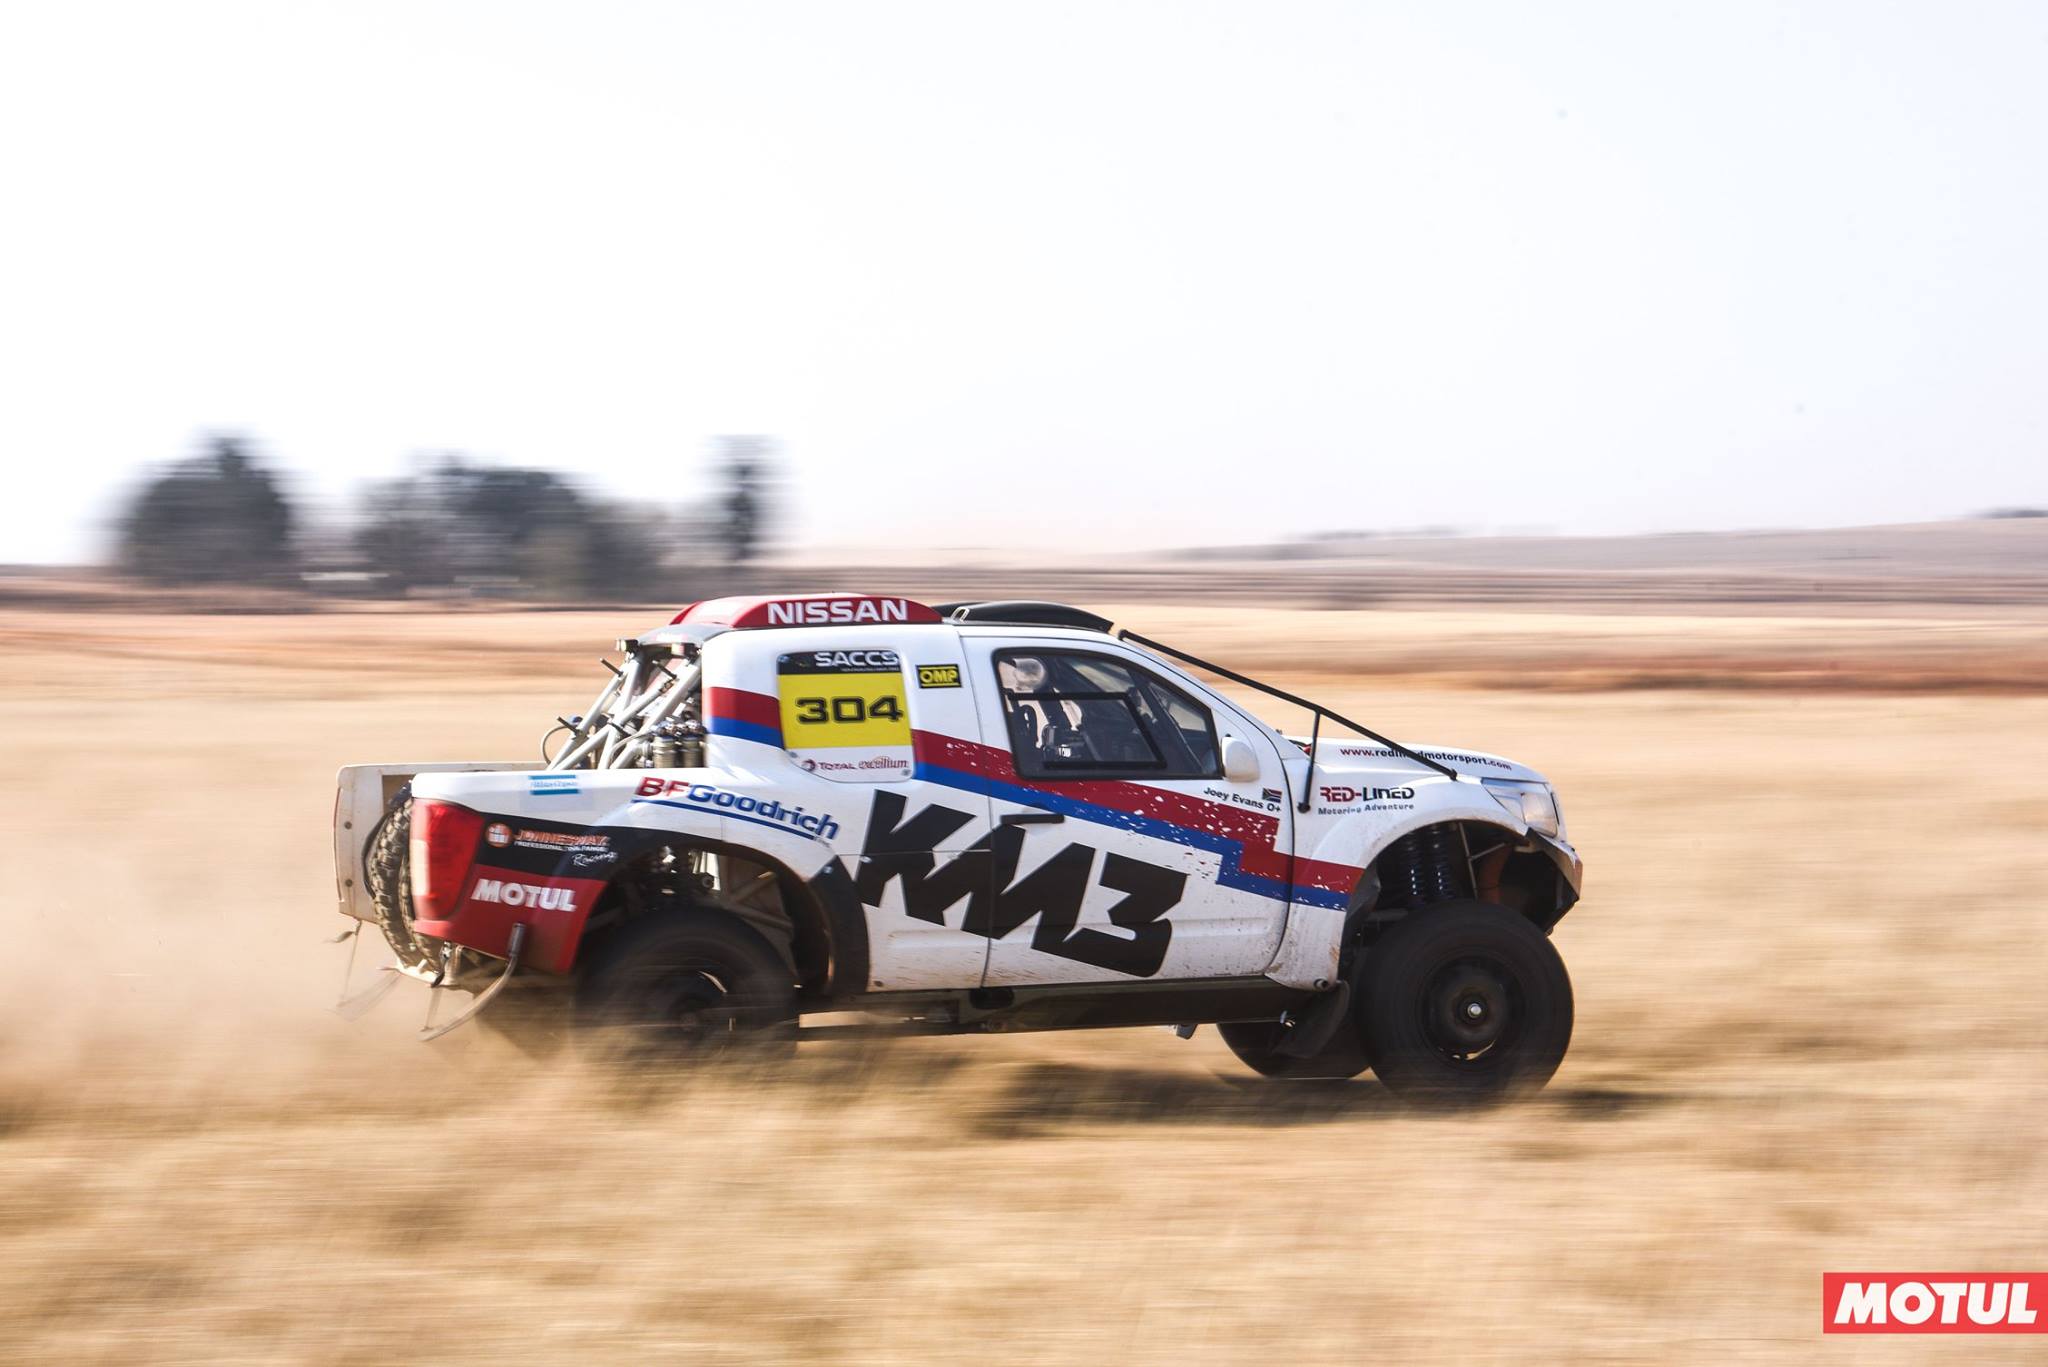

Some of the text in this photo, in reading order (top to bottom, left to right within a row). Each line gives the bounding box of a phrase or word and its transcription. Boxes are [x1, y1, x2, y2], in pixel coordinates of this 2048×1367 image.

[767, 600, 908, 625] NISSAN
[814, 651, 899, 667] SACCS
[920, 669, 957, 683] OMP
[796, 695, 903, 724] 304
[818, 761, 856, 770] TOTAL
[634, 776, 839, 840] BFGoodrich
[1204, 787, 1229, 801] Joey
[1232, 793, 1264, 809] Evans
[1365, 802, 1414, 812] Adventure
[471, 878, 576, 911] MOTUL
